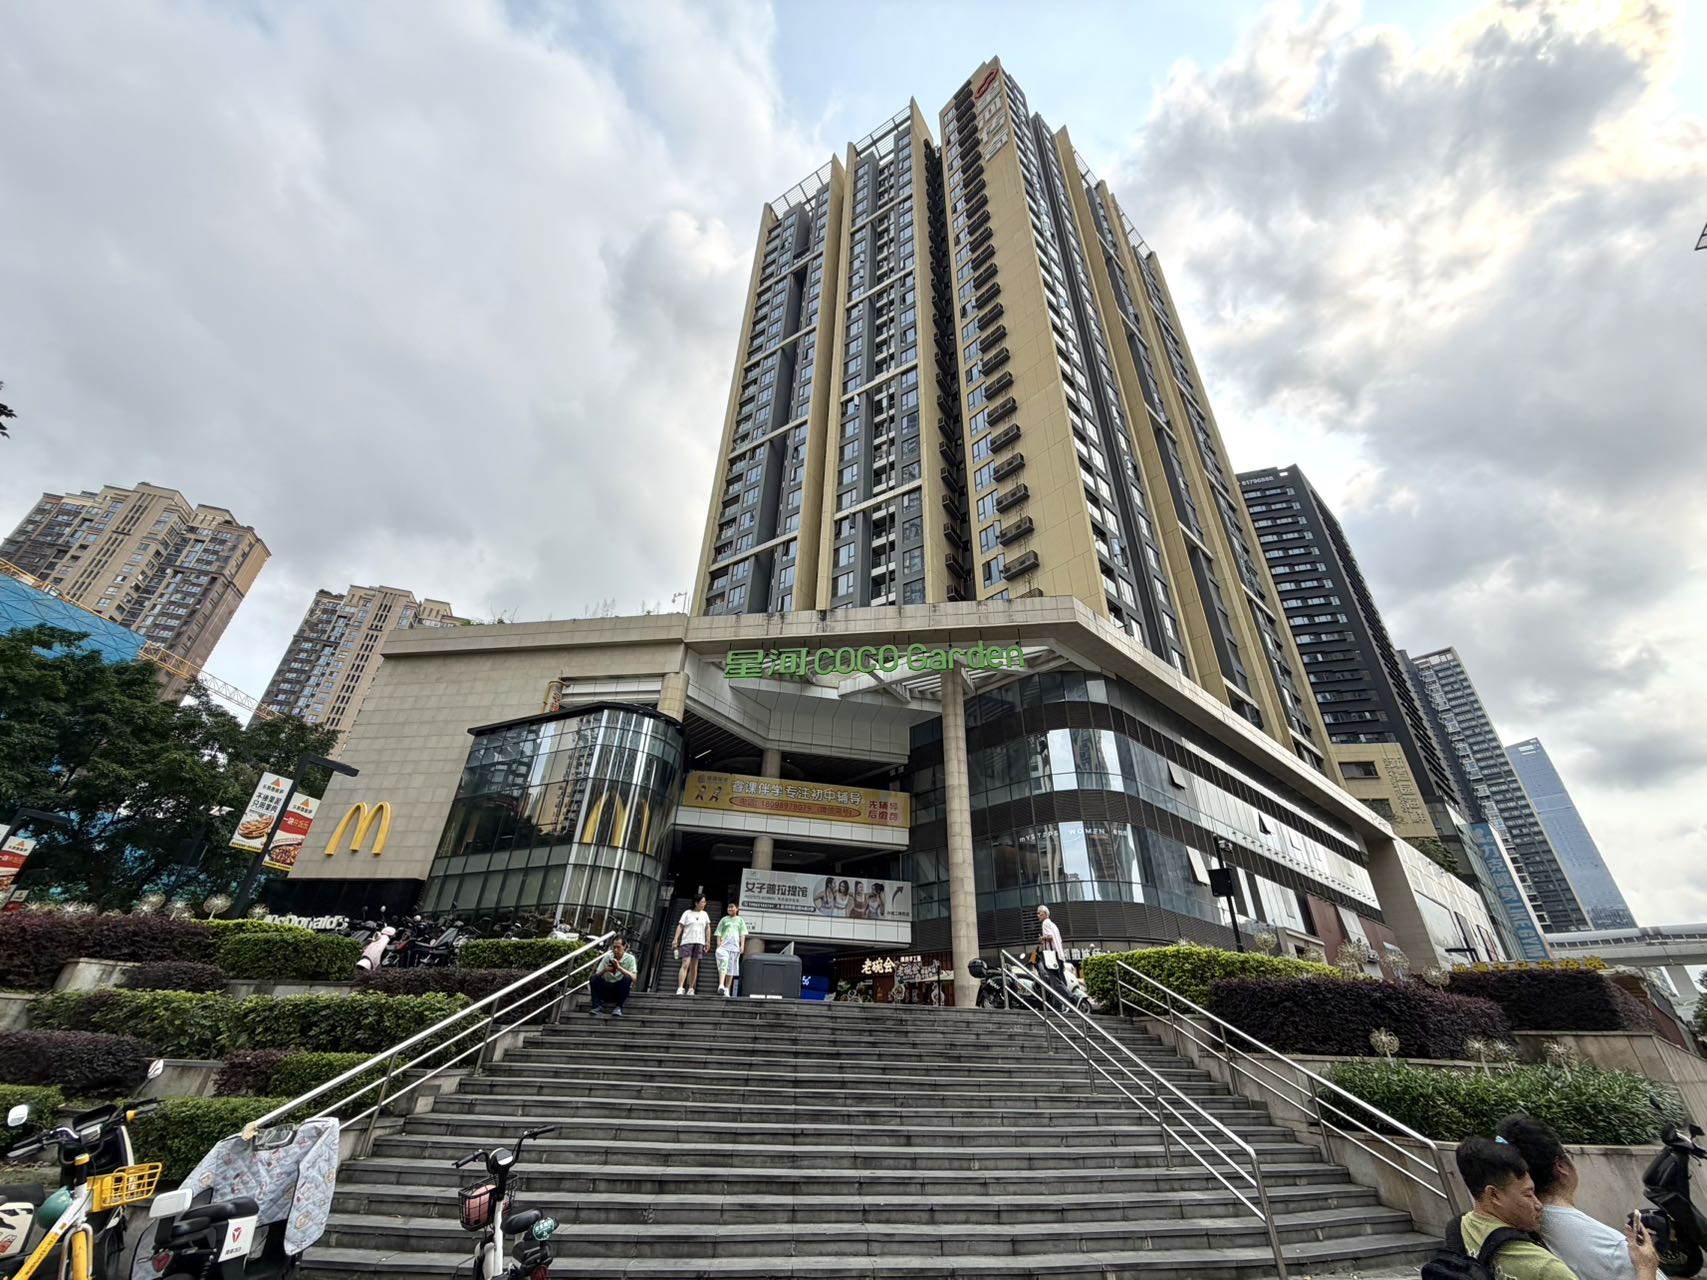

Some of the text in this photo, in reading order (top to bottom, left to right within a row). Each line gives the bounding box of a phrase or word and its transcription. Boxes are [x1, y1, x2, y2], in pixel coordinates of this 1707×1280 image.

[723, 640, 1025, 679] 星河 COCO Garden
[745, 881, 808, 898] 女子普拉提馆
[861, 957, 896, 974] 老碗会
